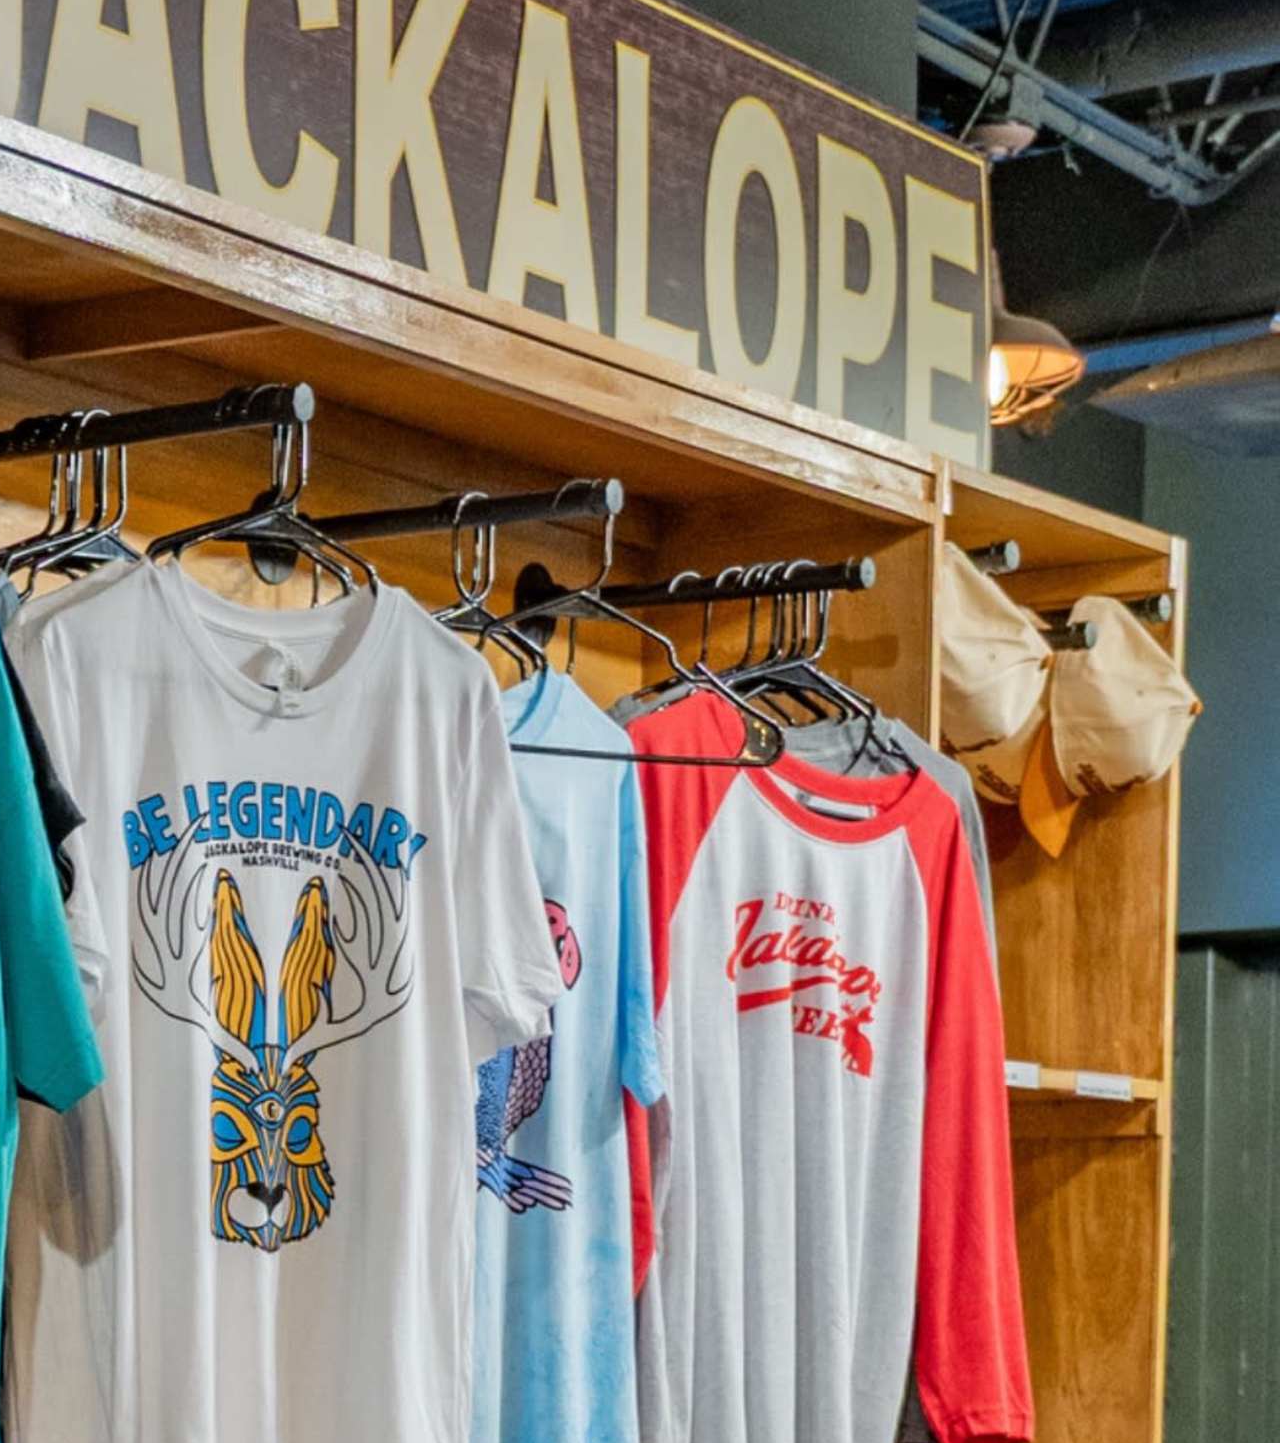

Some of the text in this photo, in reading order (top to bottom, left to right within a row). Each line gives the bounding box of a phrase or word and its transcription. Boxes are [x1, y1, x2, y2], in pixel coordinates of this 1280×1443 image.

[122, 781, 428, 881] BE LEGENDARY
[204, 842, 270, 859] JACKALOPE
[272, 842, 322, 865] BREWING
[242, 855, 300, 872] NASHVILLE
